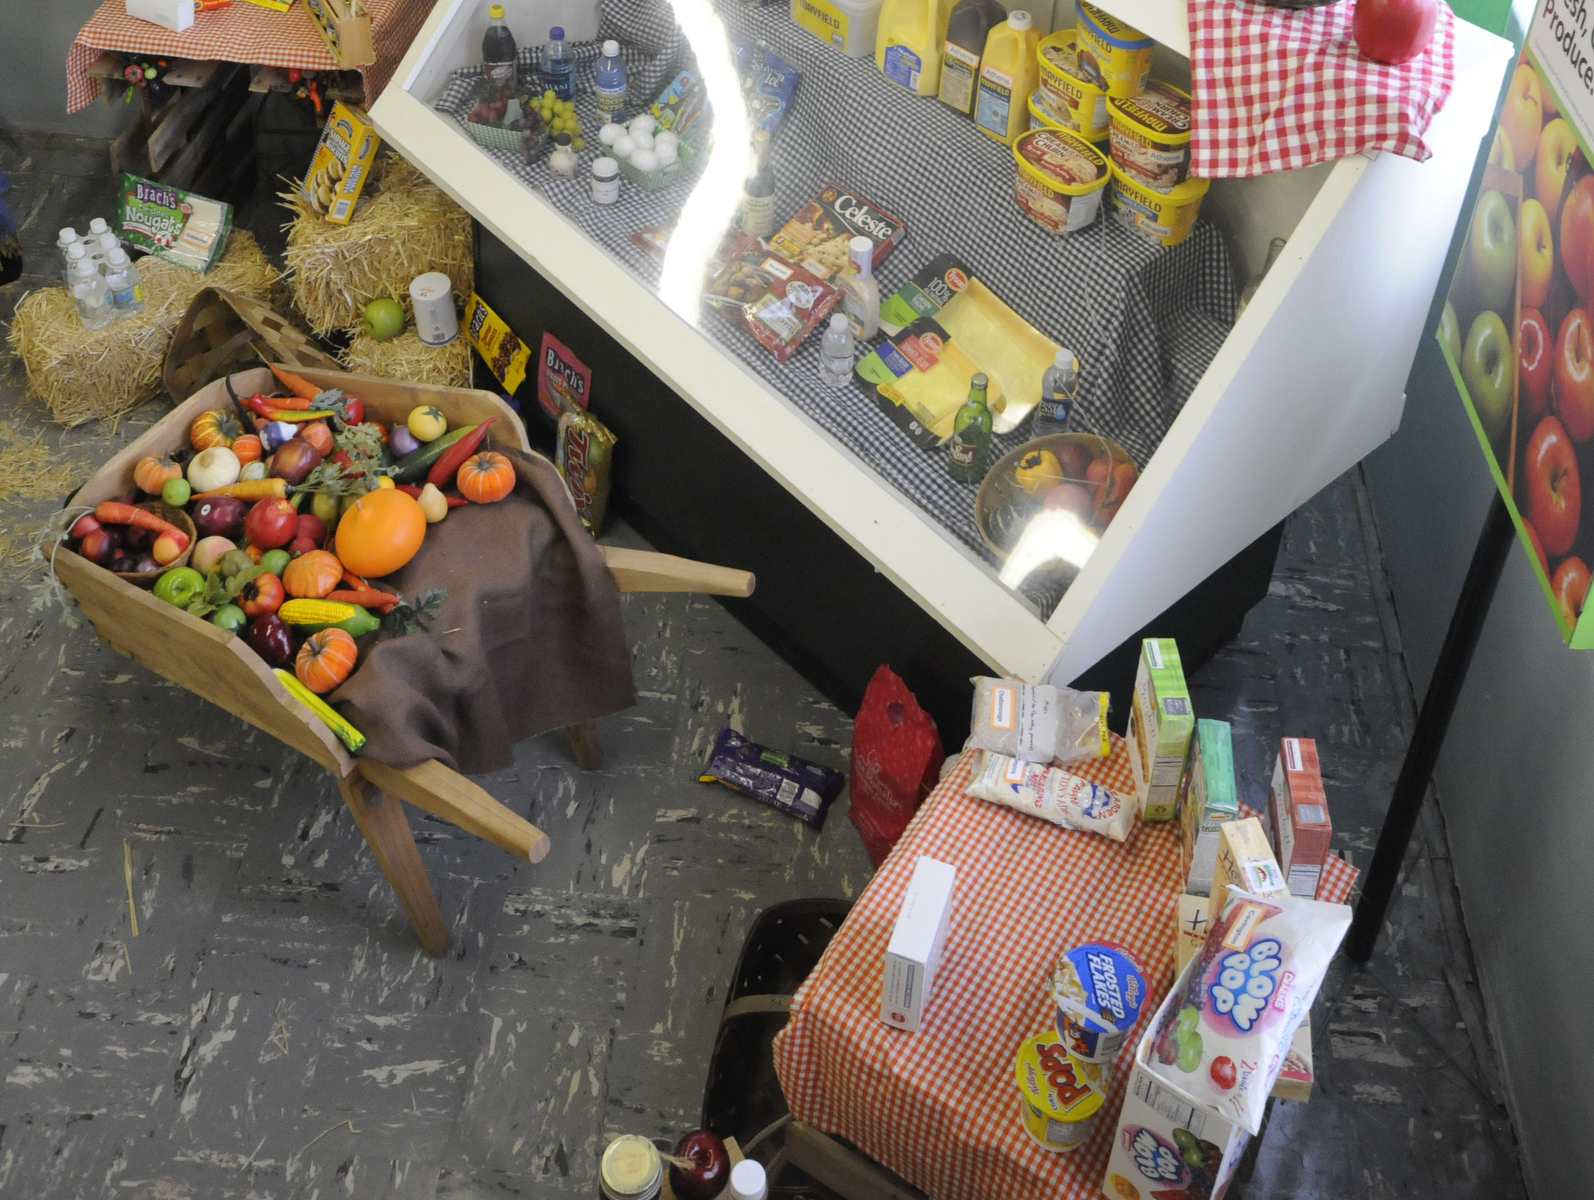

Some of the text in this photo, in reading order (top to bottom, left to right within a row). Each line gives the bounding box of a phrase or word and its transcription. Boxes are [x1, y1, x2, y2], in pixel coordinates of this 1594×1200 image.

[949, 46, 975, 63] Athens
[985, 68, 1010, 86] Athens
[1040, 65, 1083, 100] MAYFIELD
[1114, 98, 1168, 132] MAYFIELD
[1033, 139, 1067, 158] CHURN
[1056, 131, 1104, 166] MAYFIELD
[1150, 151, 1180, 162] Athens
[136, 183, 177, 209] Brach's
[1114, 178, 1162, 213] MAYFIELD
[125, 205, 183, 235] Nougats
[834, 195, 893, 240] Celeste
[1140, 220, 1168, 236] Athens
[927, 276, 951, 302] 100%
[948, 270, 965, 289] Tyson
[547, 349, 585, 394] Brach's
[1230, 910, 1255, 945] Covington
[1087, 953, 1111, 1008] FLAKES
[1099, 952, 1125, 1020] FROSTED
[1126, 974, 1139, 1010] Kellogg's
[1208, 951, 1250, 1015] POP
[1231, 938, 1282, 1032] BLOW
[1273, 971, 1295, 1012] CHARMS
[1024, 1062, 1040, 1096] Kellogg's
[1036, 1043, 1093, 1112] POPS
[1047, 1092, 1058, 1111] CORN
[1132, 1128, 1161, 1180] BLOW
[1156, 1145, 1180, 1181] POP
